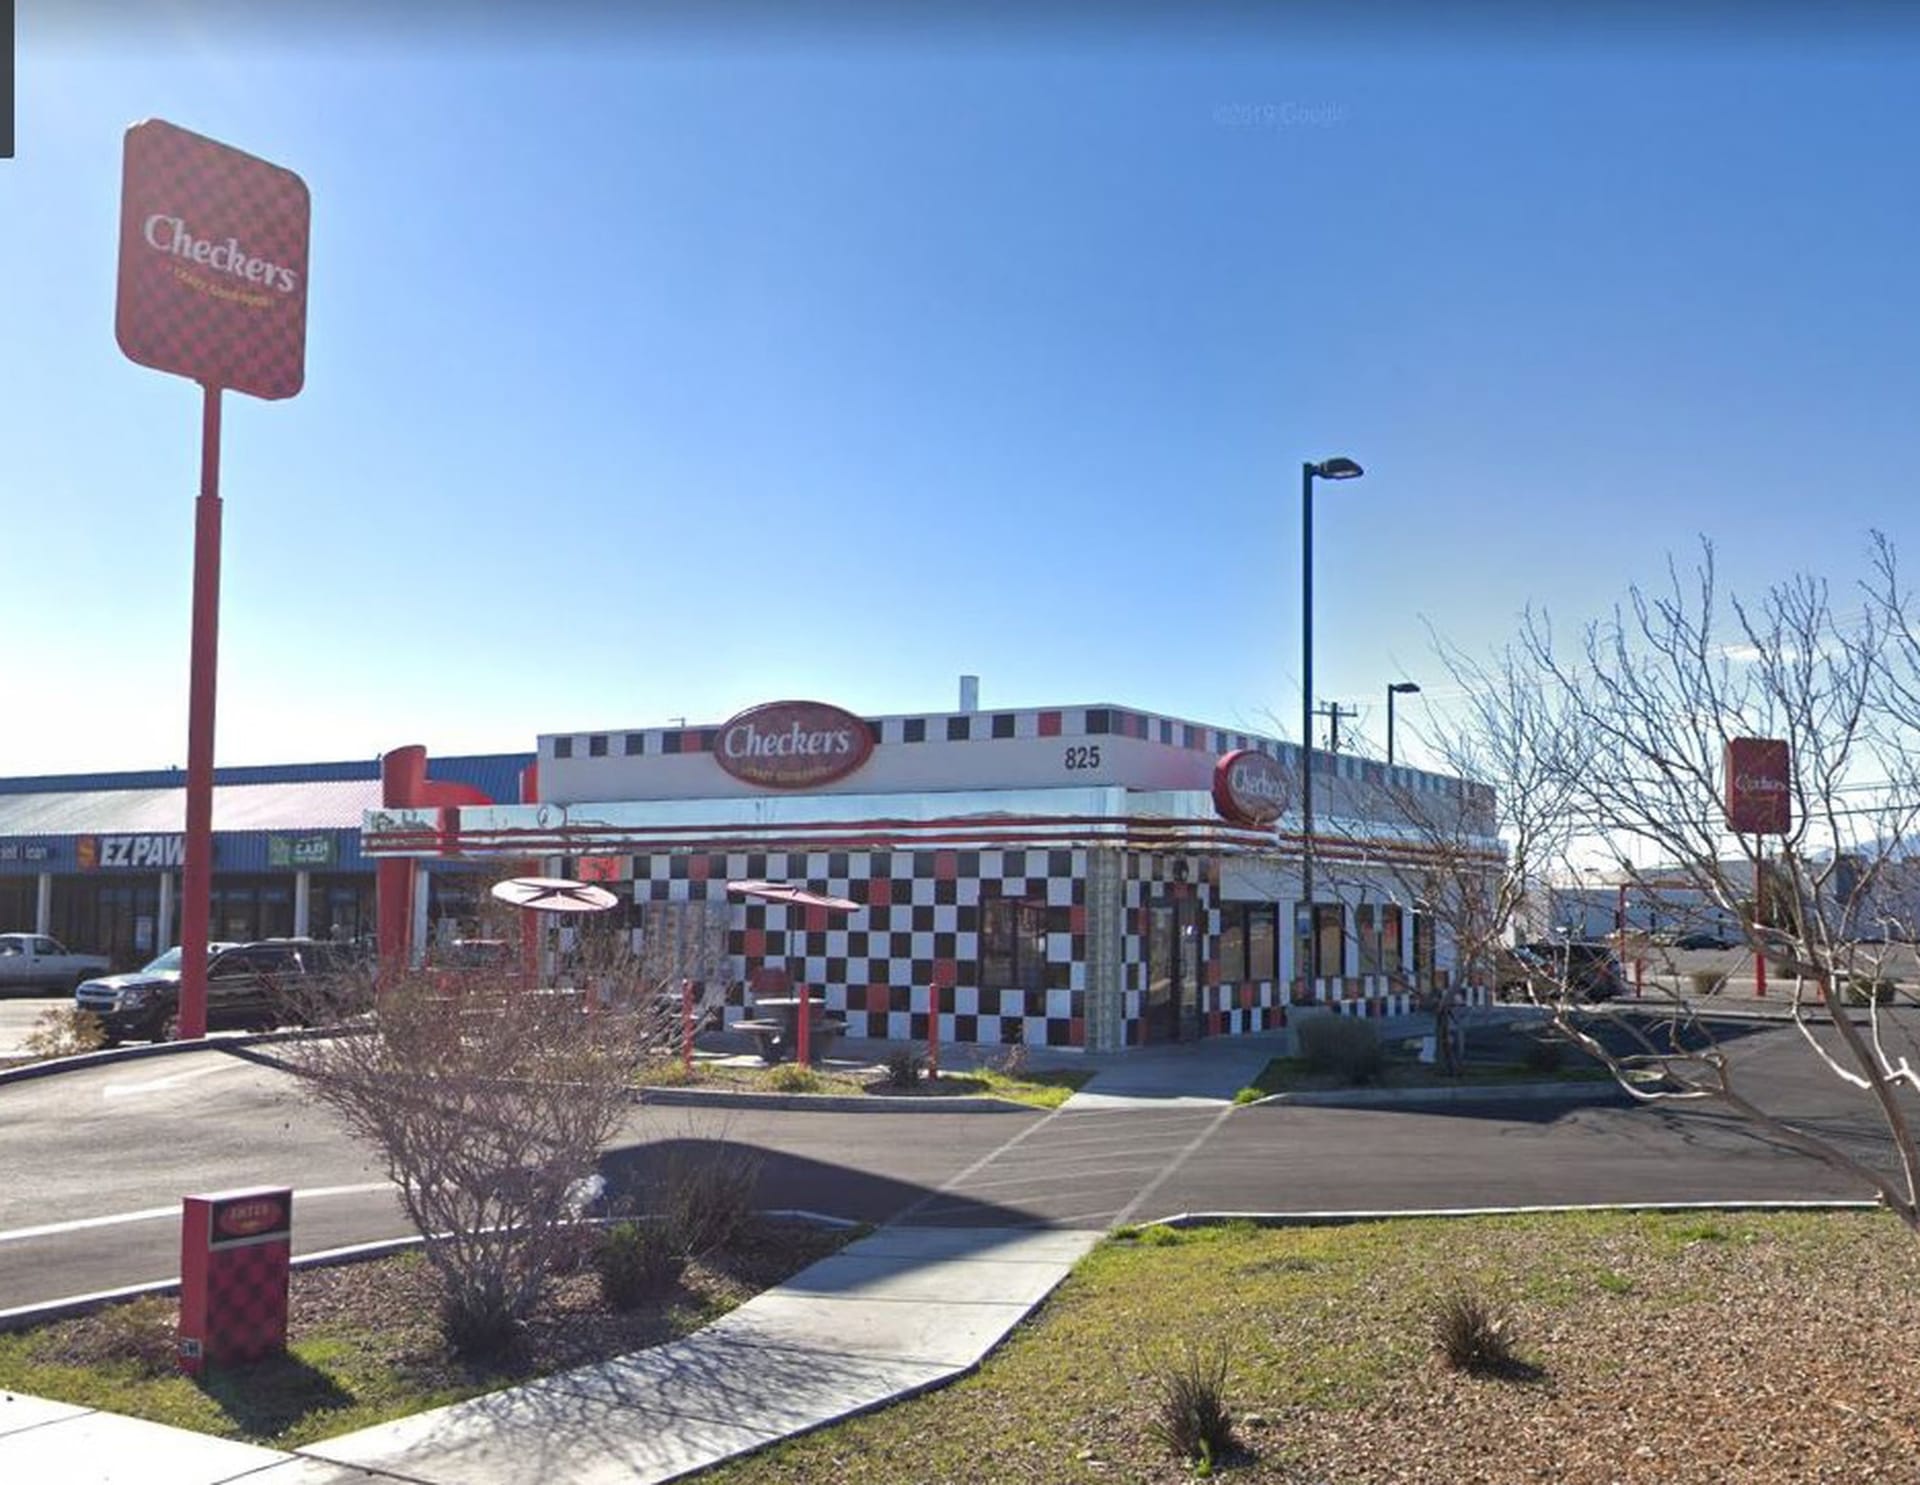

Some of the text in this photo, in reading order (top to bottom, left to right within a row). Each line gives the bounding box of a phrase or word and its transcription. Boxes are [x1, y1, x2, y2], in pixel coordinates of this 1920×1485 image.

[143, 214, 298, 293] Checkers
[724, 721, 851, 758] Checkers
[1064, 746, 1101, 770] 825
[101, 835, 187, 867] EZPAW
